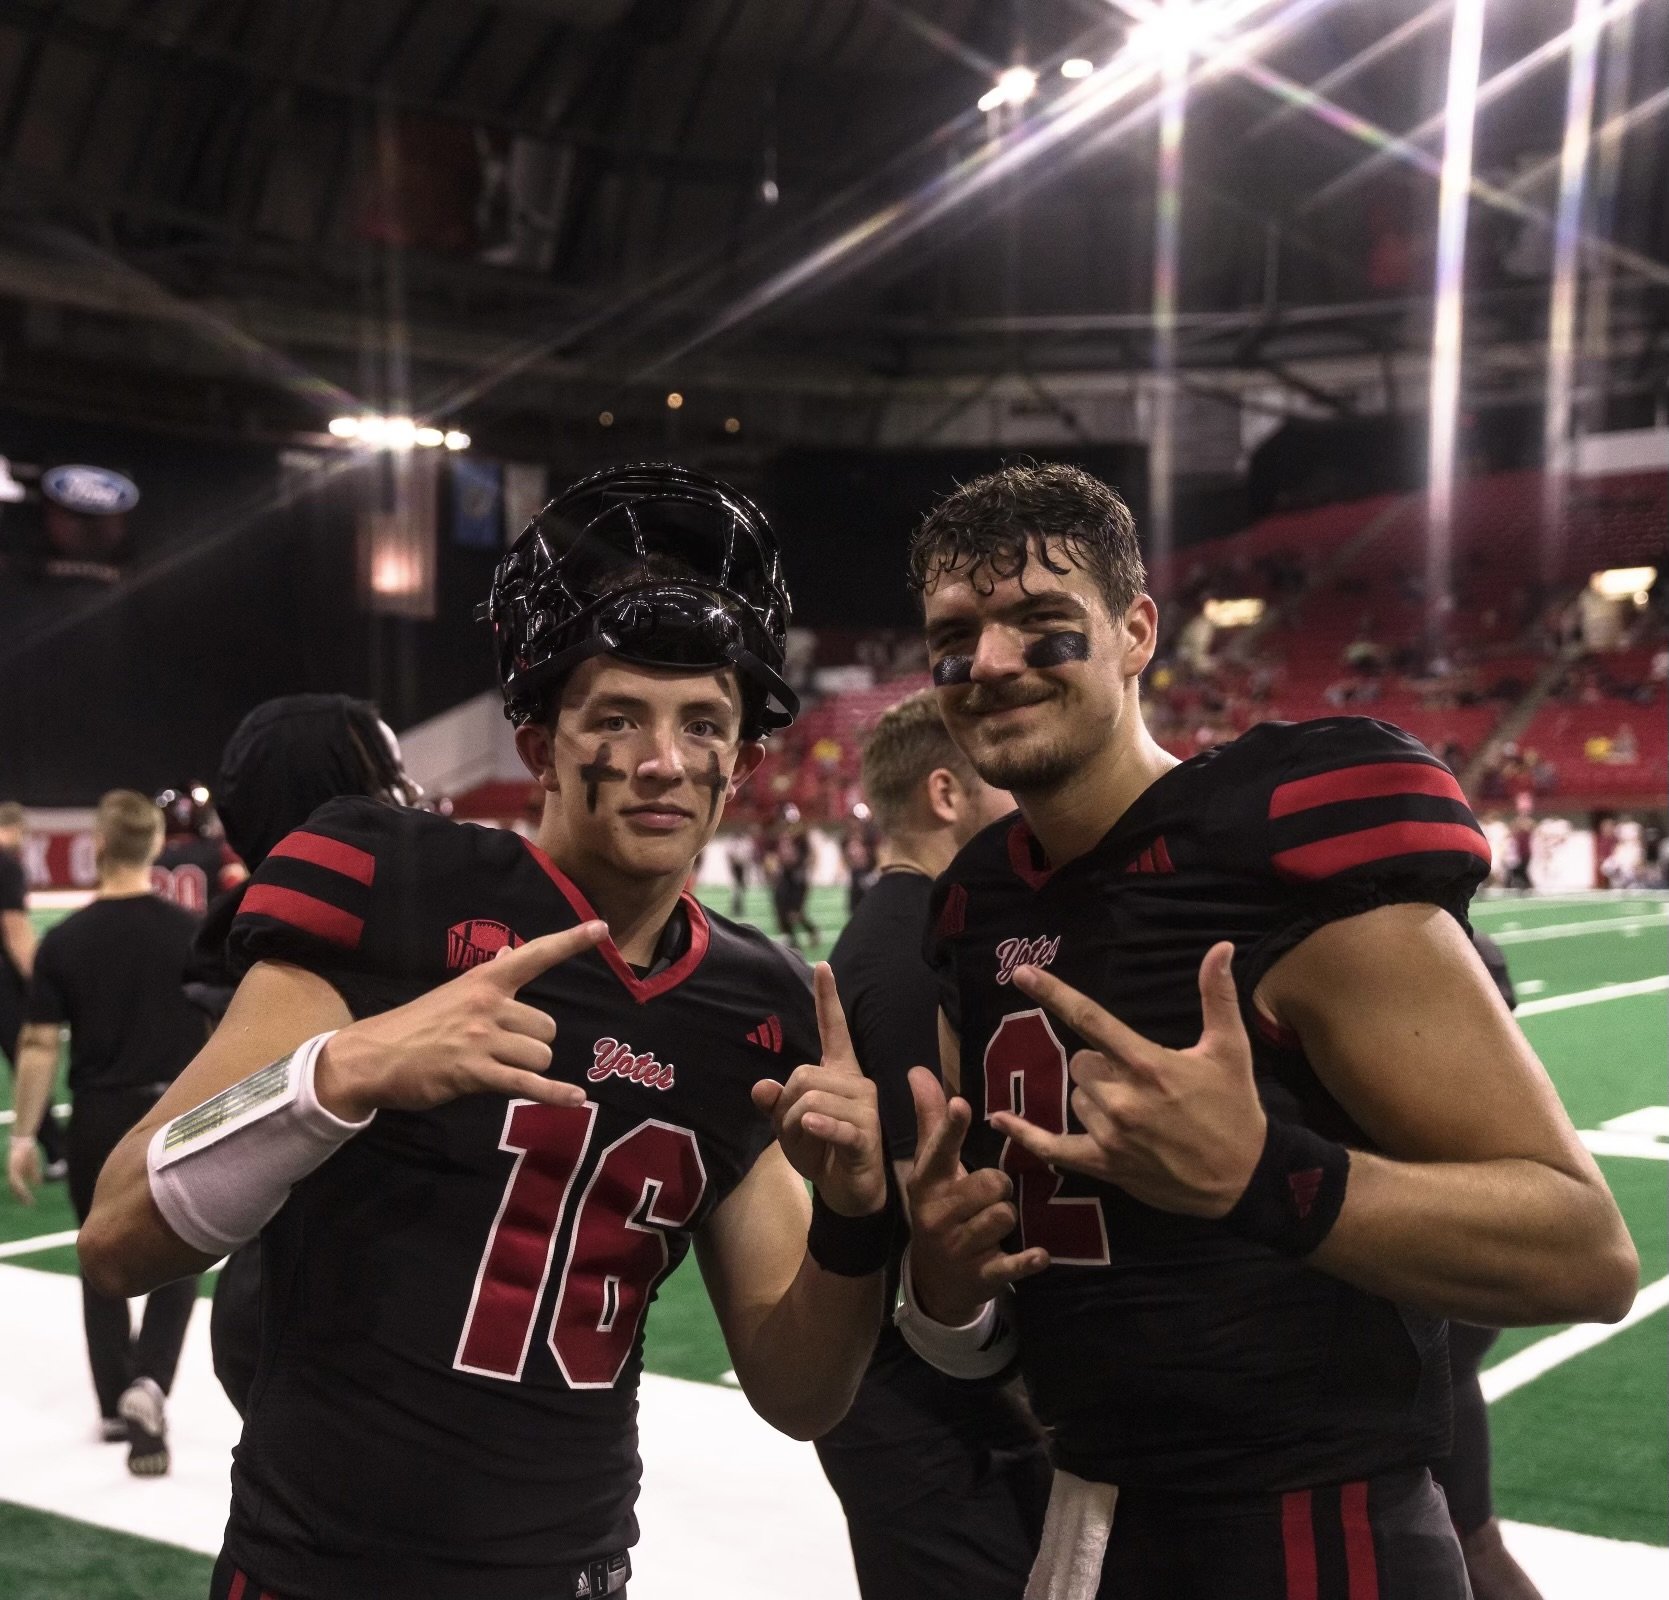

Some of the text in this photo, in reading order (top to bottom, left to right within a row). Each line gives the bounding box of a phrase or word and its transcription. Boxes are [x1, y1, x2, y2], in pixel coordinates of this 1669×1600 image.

[586, 1036, 676, 1092] Yotes
[983, 1007, 1111, 1266] 2
[452, 1097, 708, 1390] 16
